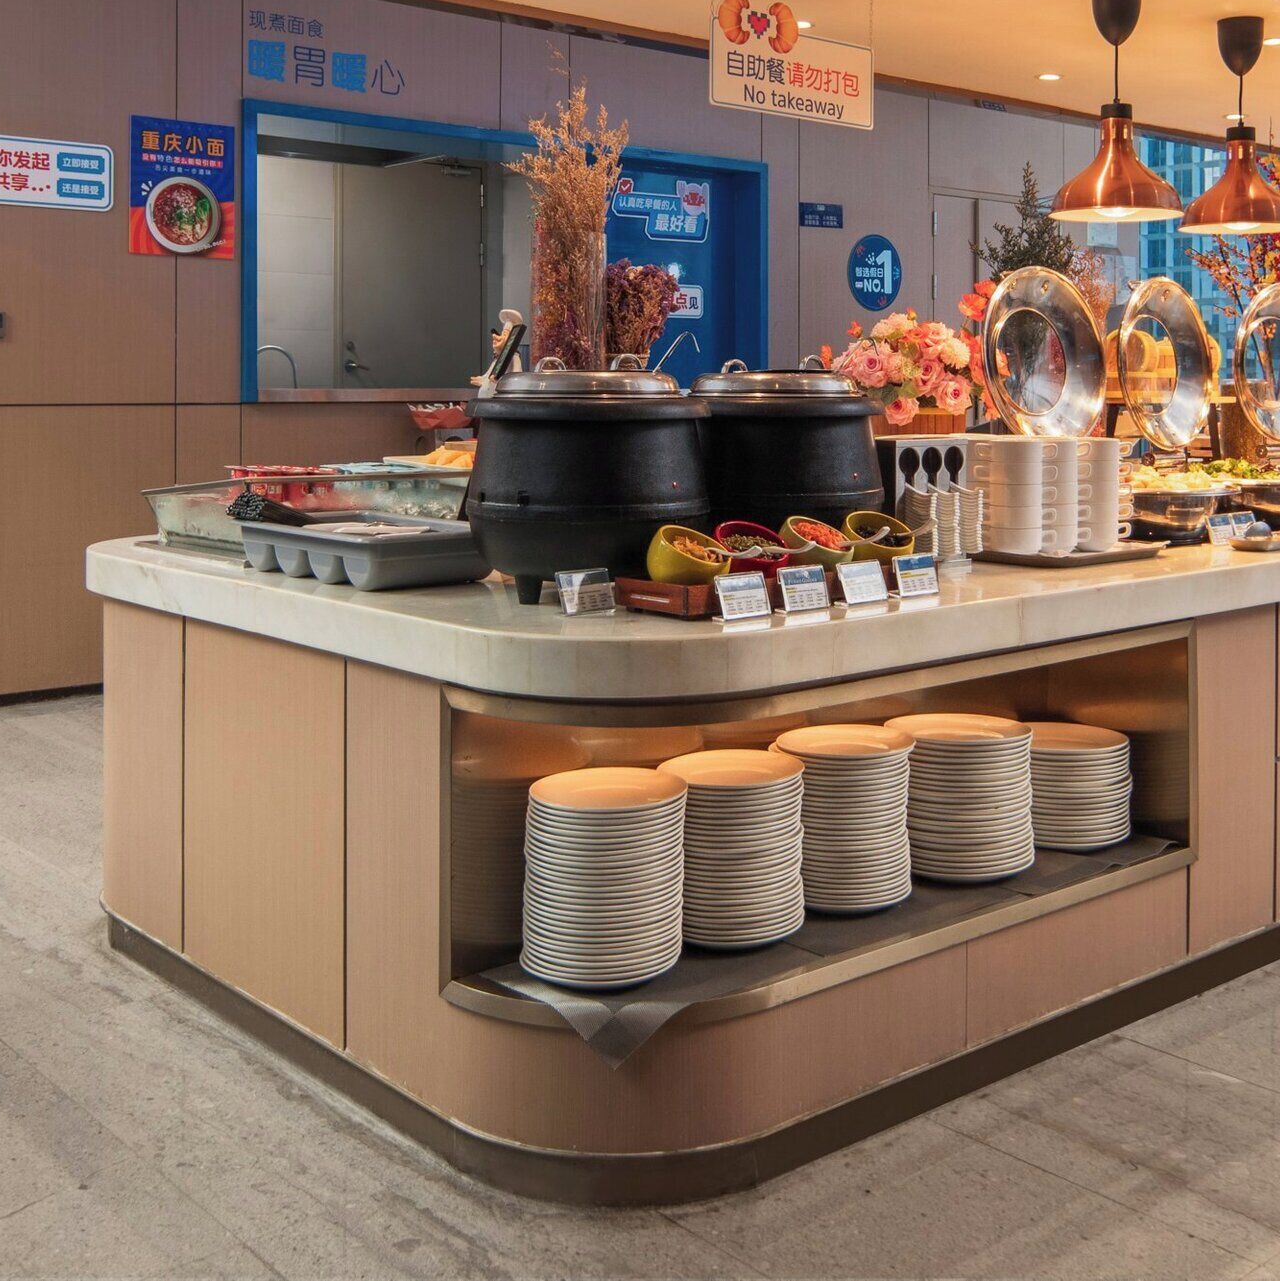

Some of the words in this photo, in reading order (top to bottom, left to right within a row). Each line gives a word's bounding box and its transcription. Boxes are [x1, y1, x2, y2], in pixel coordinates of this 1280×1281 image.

[249, 9, 324, 39] 现煮面食
[248, 39, 405, 96] 暖胃暖心
[727, 50, 860, 98] 自助餐请勿打包
[743, 83, 766, 105] No
[771, 89, 845, 120] takeaway
[141, 130, 224, 157] 重庆小面
[62, 157, 100, 171] 立即接受
[618, 196, 678, 212] 认真吃早餐的人
[654, 213, 698, 233] 最好看
